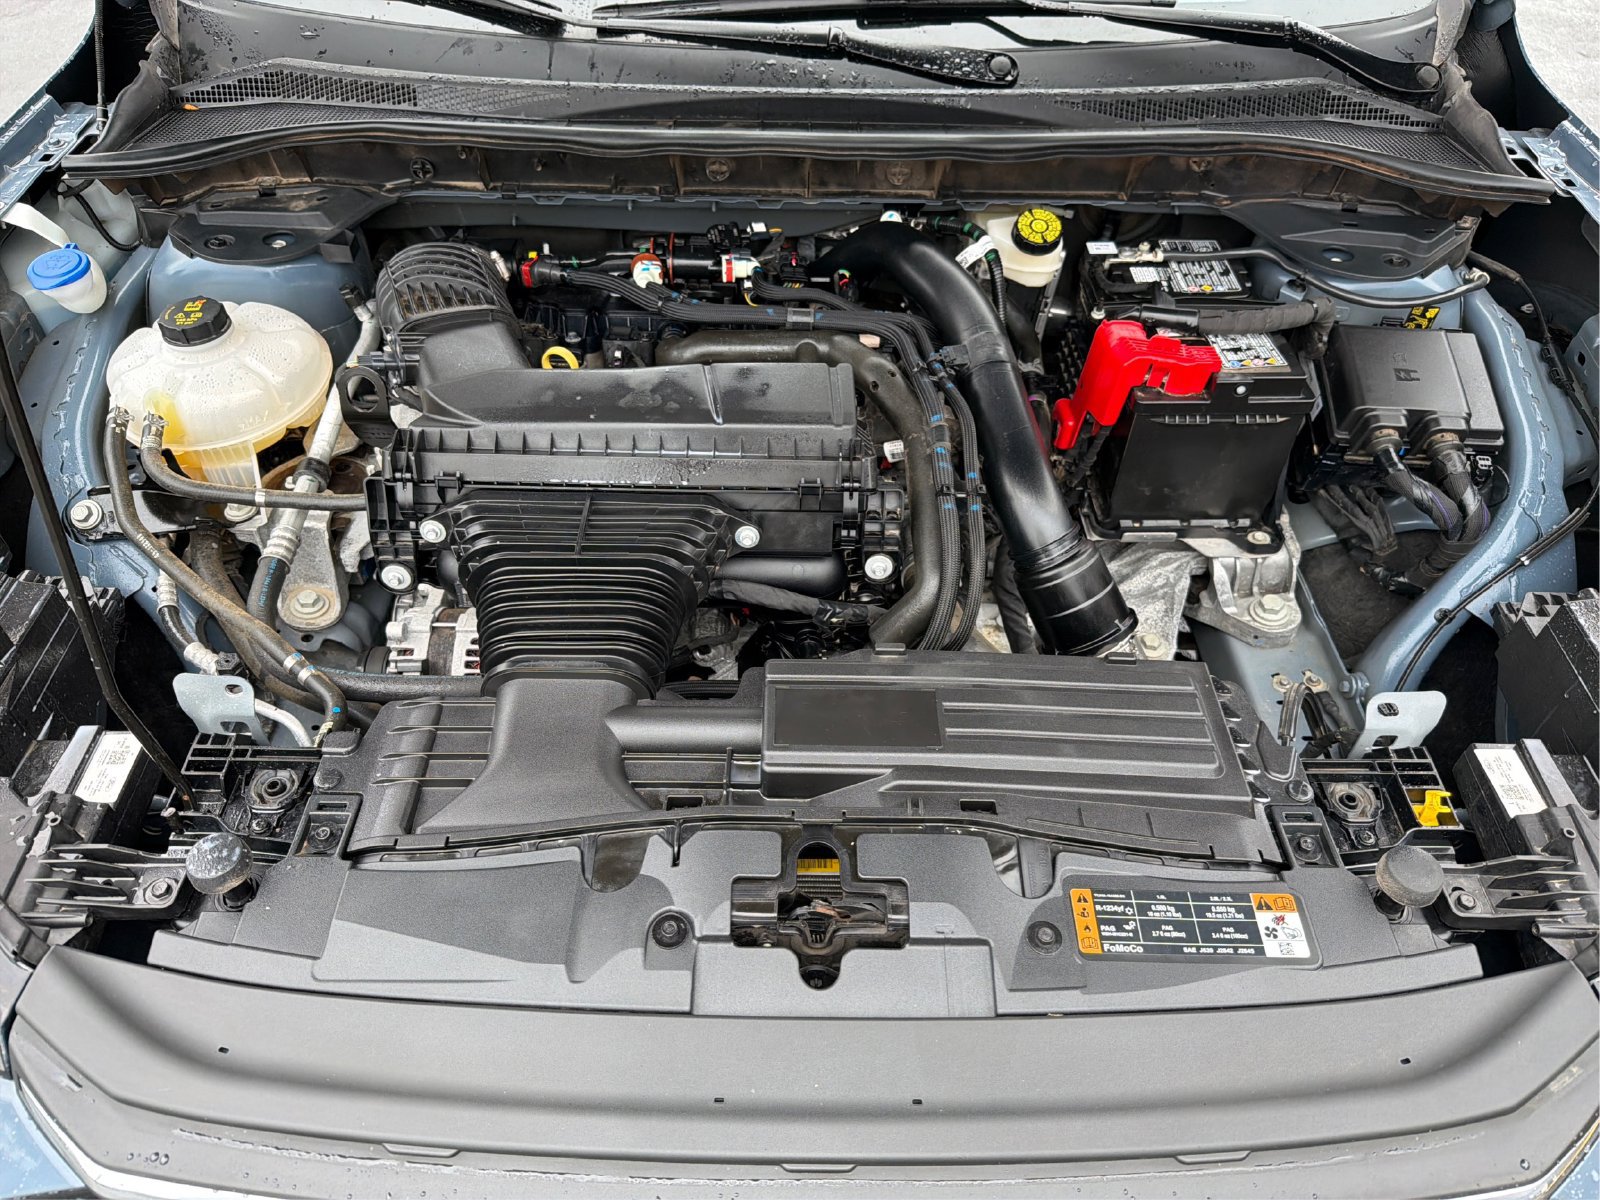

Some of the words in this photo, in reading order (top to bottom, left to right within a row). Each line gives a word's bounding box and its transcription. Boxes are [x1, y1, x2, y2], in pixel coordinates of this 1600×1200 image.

[1095, 904, 1124, 913] R-1234yf
[1166, 904, 1176, 913] kg
[1226, 905, 1236, 914] kg
[1100, 924, 1117, 932] PAG
[1103, 943, 1144, 953] FoMoCo
